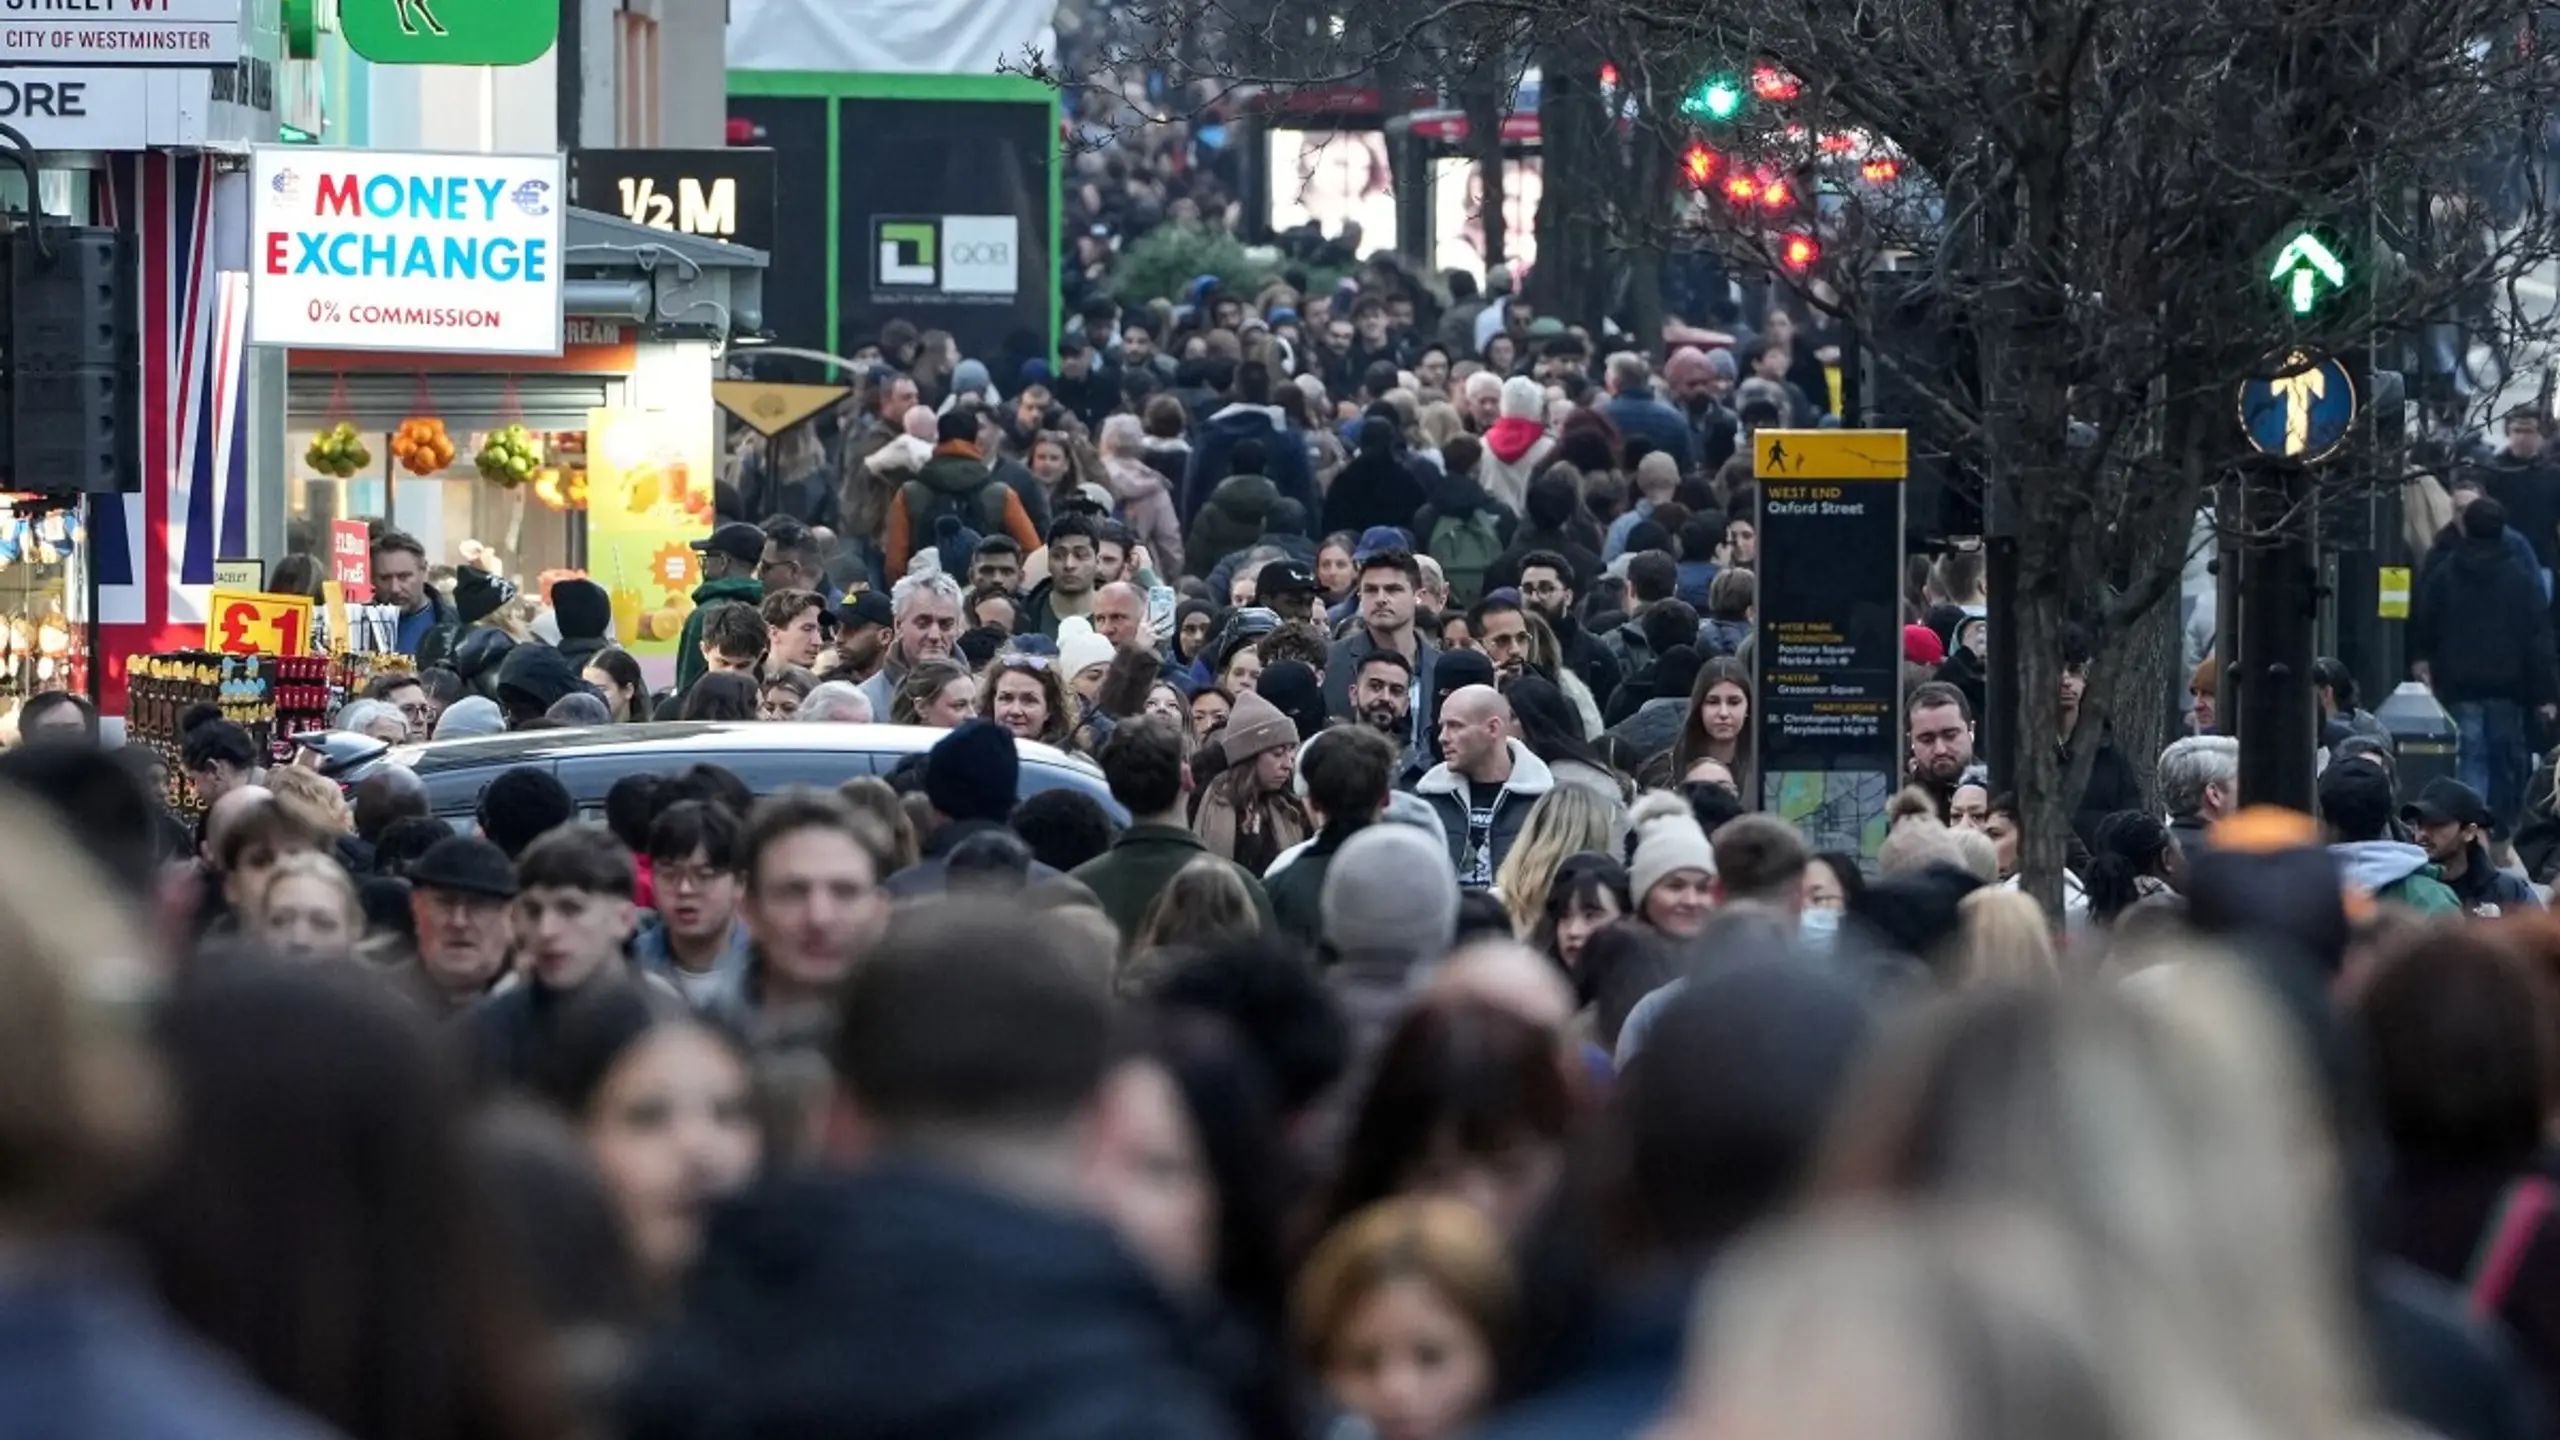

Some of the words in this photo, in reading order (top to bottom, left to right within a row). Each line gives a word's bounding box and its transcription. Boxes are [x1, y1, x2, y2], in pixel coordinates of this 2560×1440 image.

[6, 31, 46, 48] CITY
[51, 31, 74, 48] OF
[78, 31, 211, 50] WESTMINSTER
[315, 174, 507, 221] MONEY
[266, 232, 546, 282] EXCHANGE
[307, 299, 341, 323] 0%
[349, 305, 500, 327] COMMISSION
[564, 320, 619, 344] REAM
[1767, 486, 1805, 498] WEST
[1810, 487, 1842, 498] END
[1767, 501, 1817, 514] Oxford
[1821, 502, 1864, 515] Street
